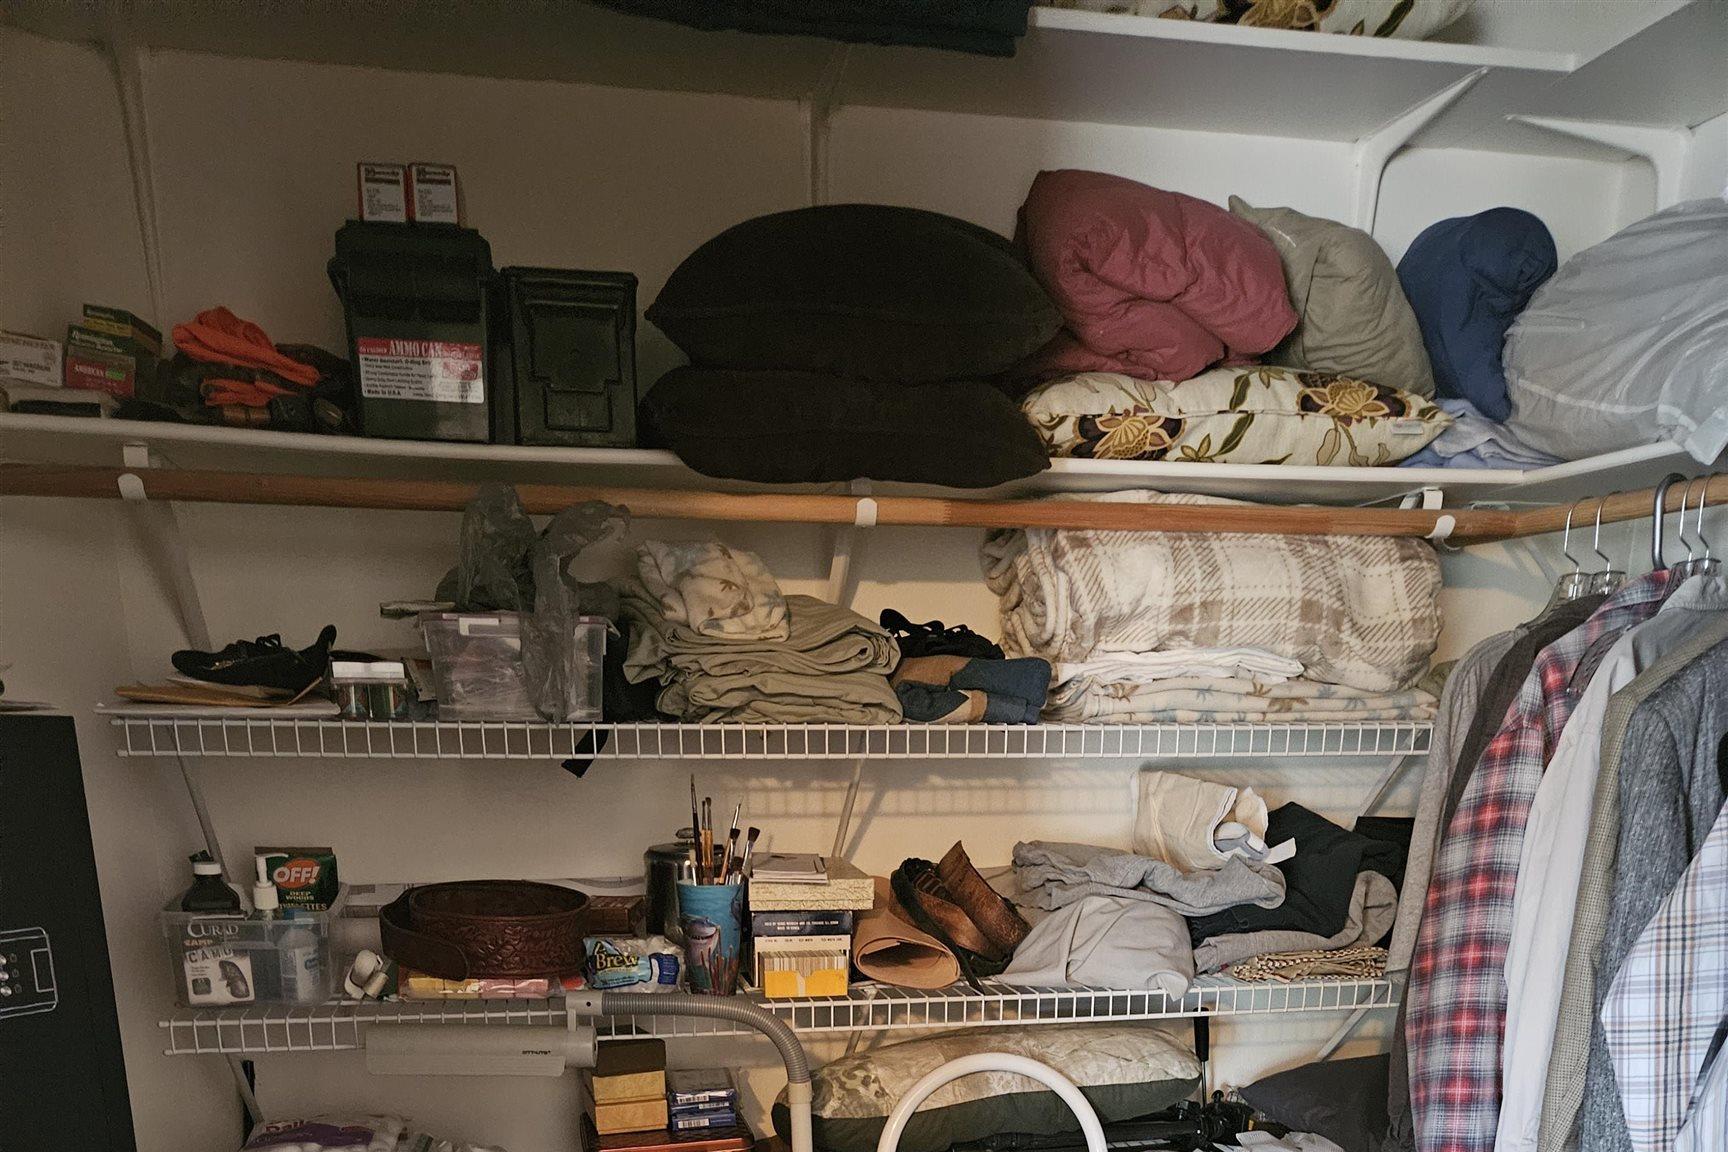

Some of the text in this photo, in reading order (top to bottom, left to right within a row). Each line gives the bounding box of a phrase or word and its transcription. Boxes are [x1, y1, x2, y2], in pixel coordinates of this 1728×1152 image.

[389, 339, 420, 357] AMMO
[273, 866, 320, 884] OFF!
[596, 952, 639, 971] Brew
